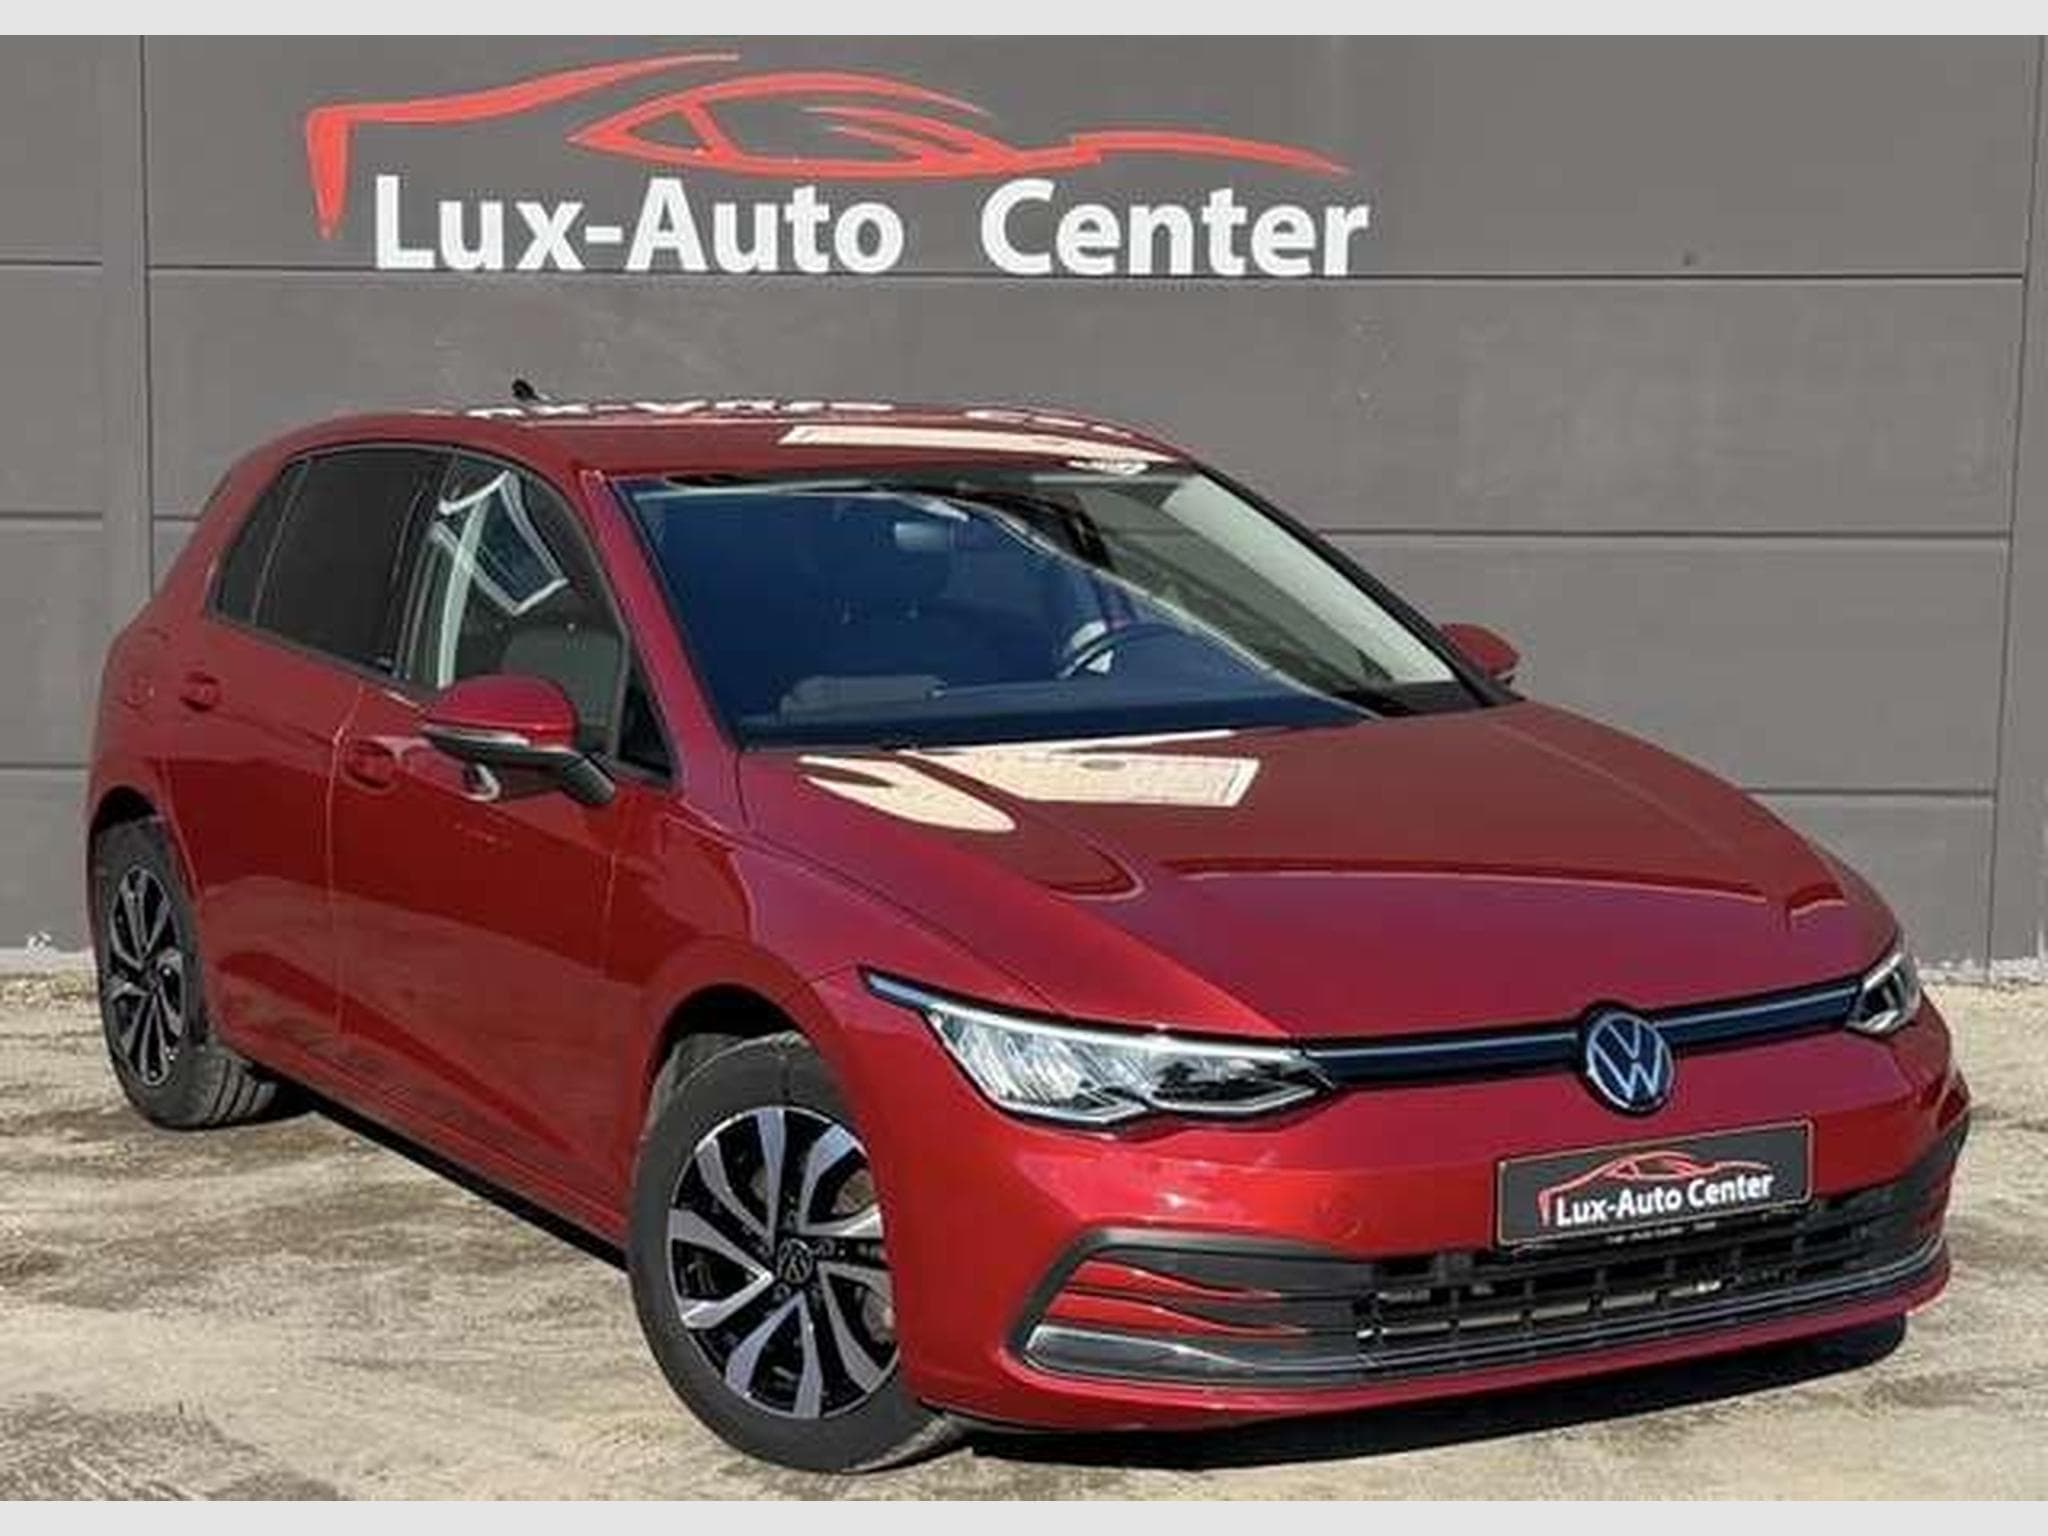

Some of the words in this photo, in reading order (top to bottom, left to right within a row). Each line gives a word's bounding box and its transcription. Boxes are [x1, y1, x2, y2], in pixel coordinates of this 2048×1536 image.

[373, 175, 905, 274] Lux-Auto
[979, 179, 1368, 279] Center
[1556, 1188, 1682, 1227] Lux-Auto
[1687, 1173, 1774, 1209] Center
